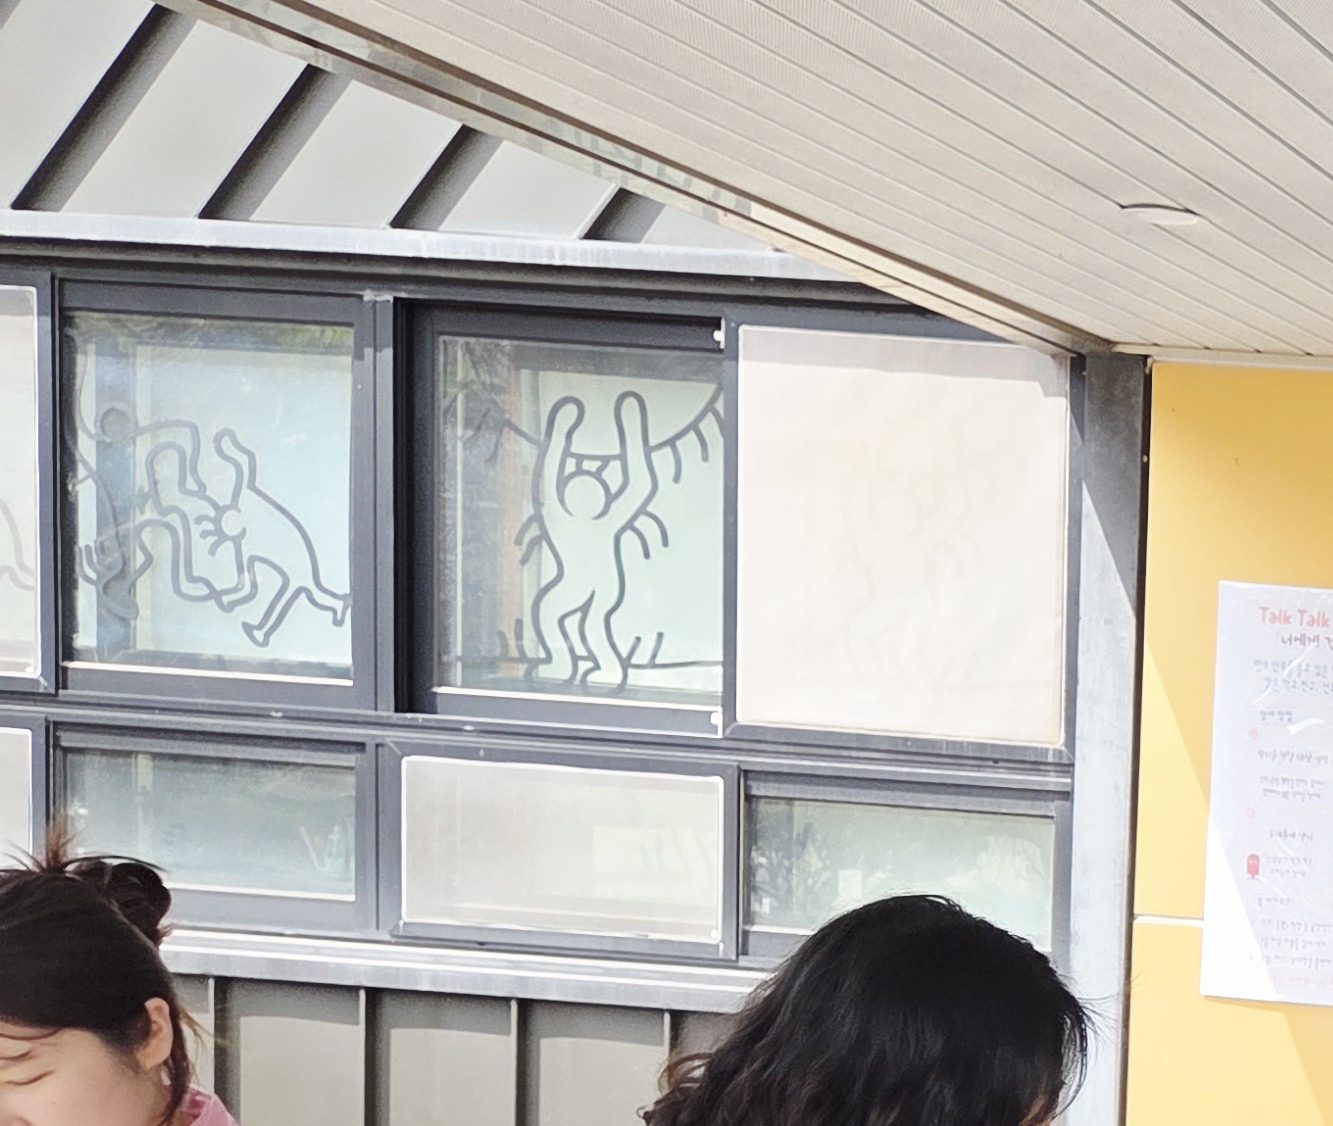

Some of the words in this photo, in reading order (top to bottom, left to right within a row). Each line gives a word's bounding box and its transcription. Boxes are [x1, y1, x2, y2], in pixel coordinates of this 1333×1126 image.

[1259, 606, 1292, 625] Talk
[1297, 609, 1331, 628] Talk
[1281, 633, 1320, 648] 너에게
